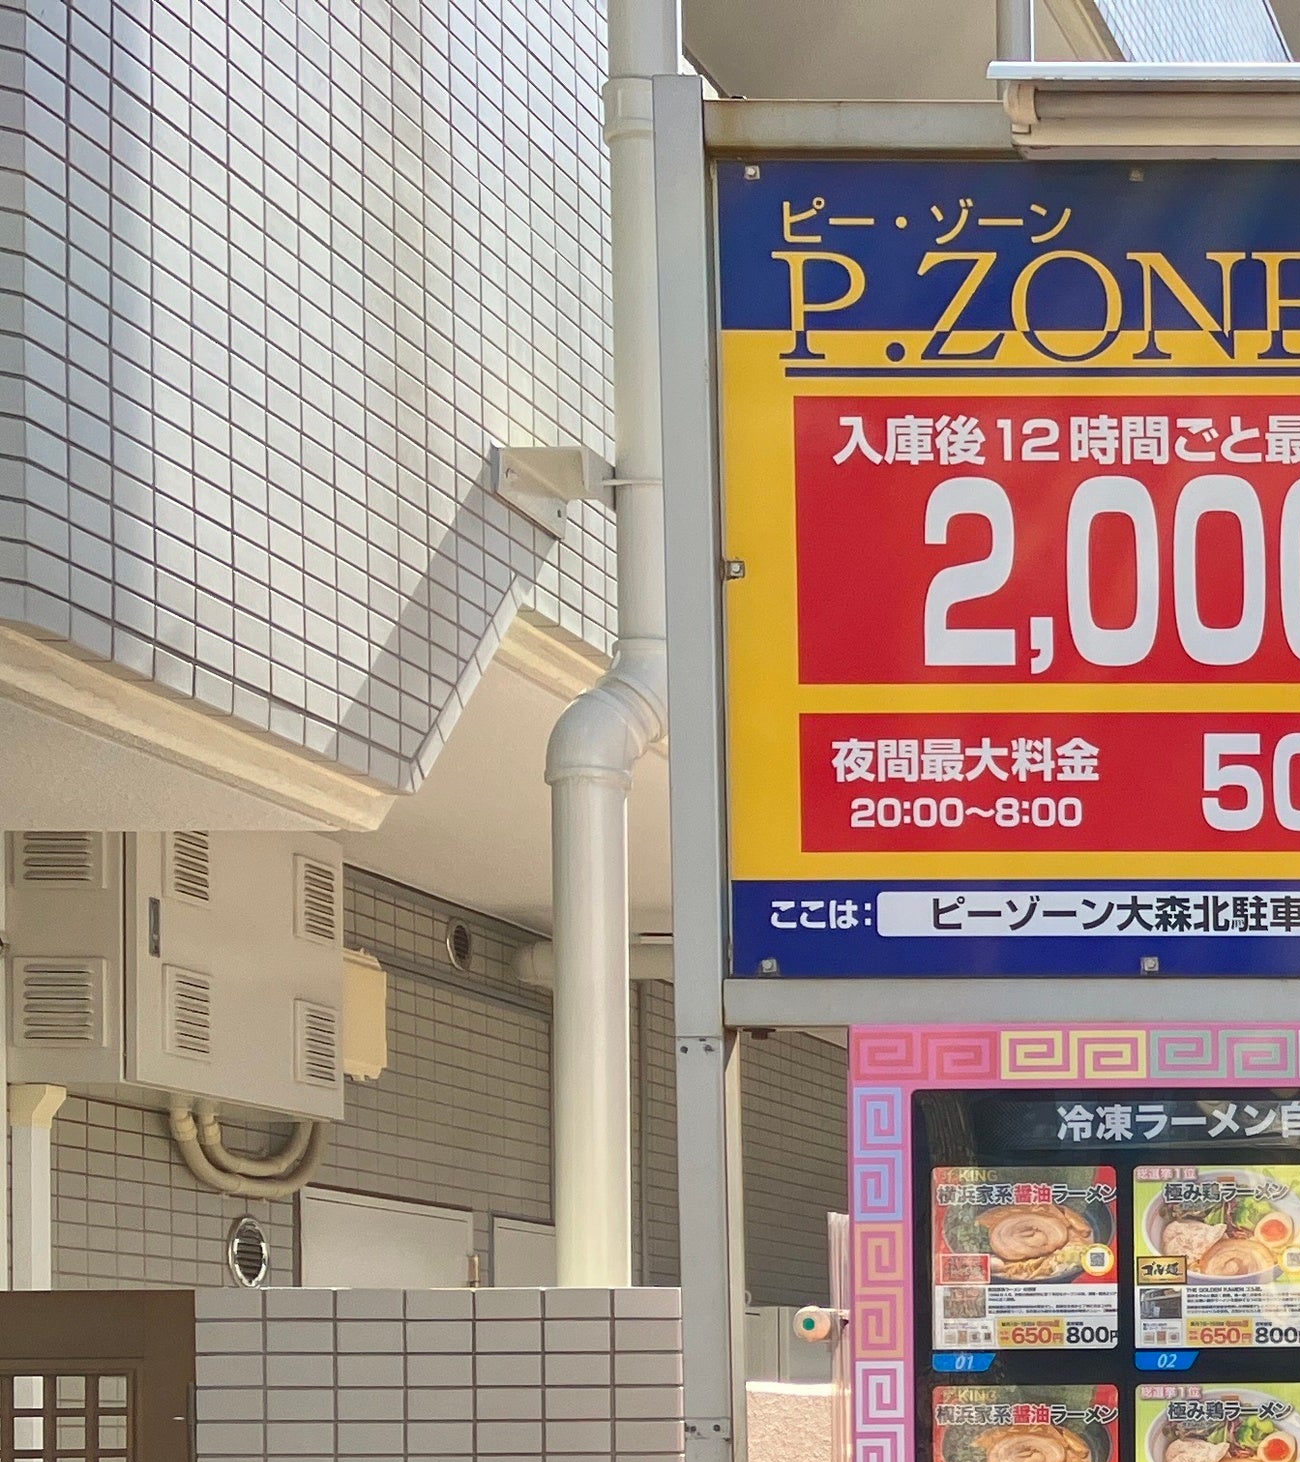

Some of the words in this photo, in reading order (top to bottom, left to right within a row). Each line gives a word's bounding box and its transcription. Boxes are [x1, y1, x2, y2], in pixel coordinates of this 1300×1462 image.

[782, 197, 1071, 245] ピー・ゾーン
[831, 737, 1100, 784] 夜間最大料金
[936, 1183, 1117, 1206] 横浜家系醤油ラーメン
[1163, 1183, 1290, 1203] 極み鶏ラーメン
[1012, 1327, 1063, 1345] 650円
[1200, 1327, 1252, 1345] 650円
[955, 1356, 974, 1370] 01
[1157, 1354, 1176, 1368] 02
[936, 1404, 1118, 1425] 横浜家系醤油ラーメン
[1167, 1402, 1293, 1421] 極み鶏ラーメン
